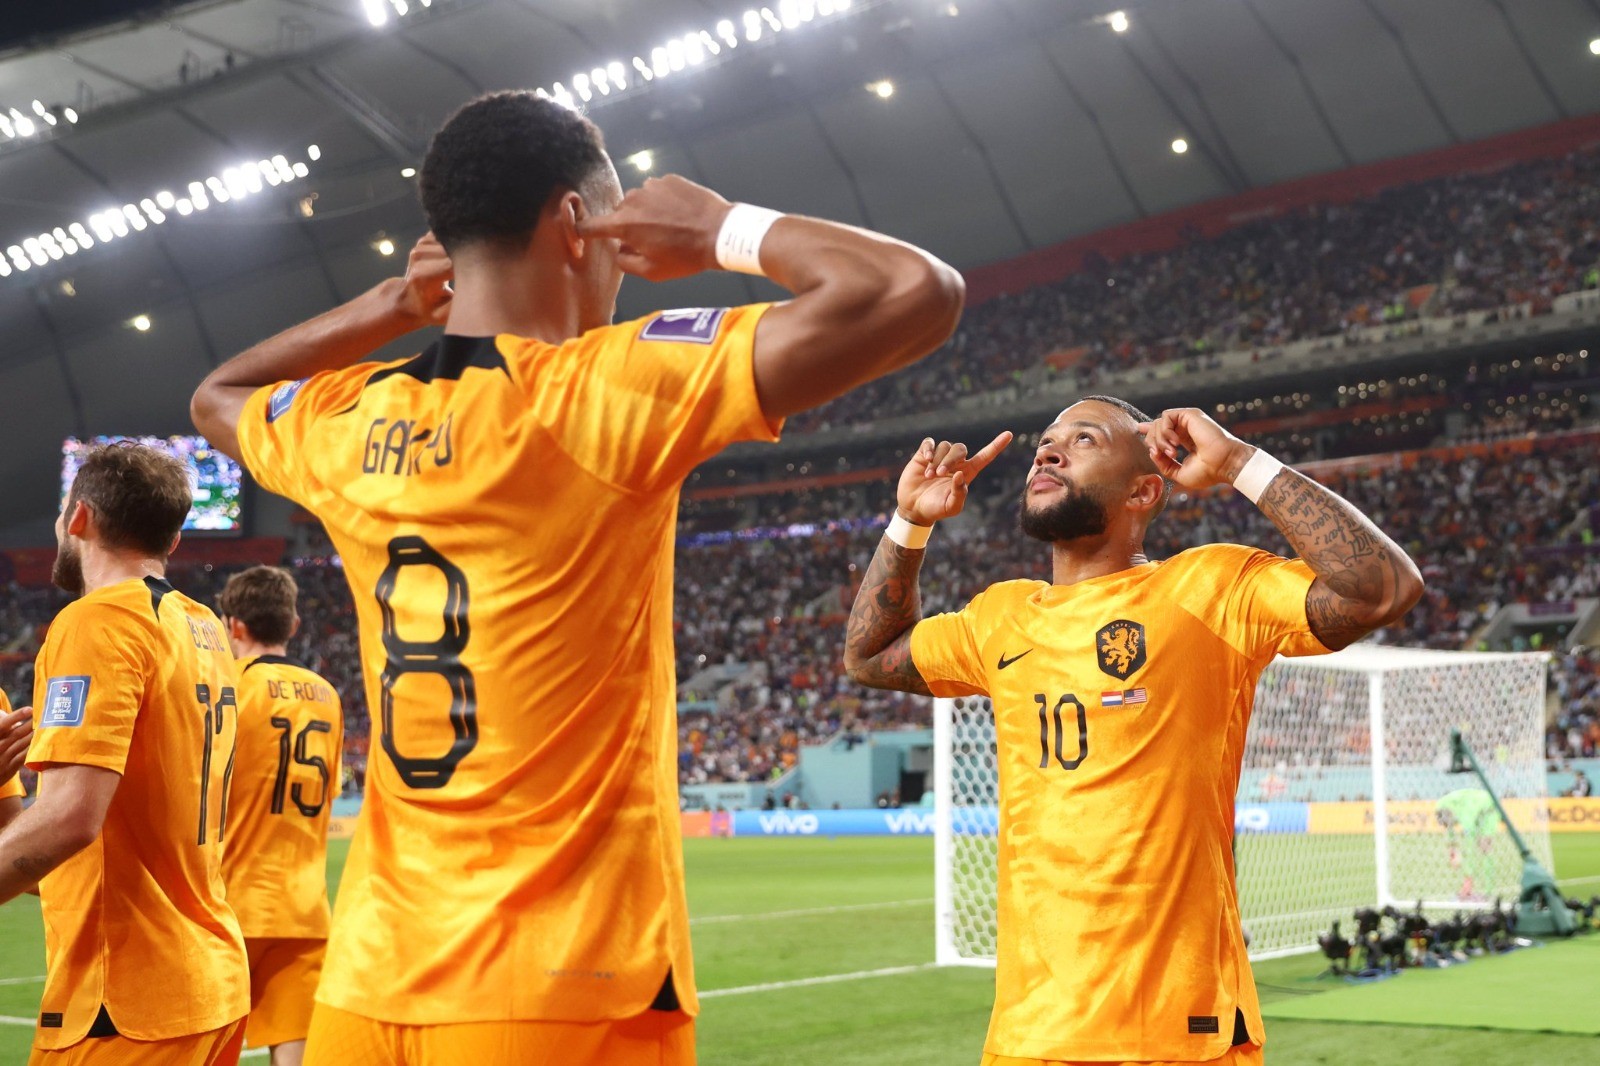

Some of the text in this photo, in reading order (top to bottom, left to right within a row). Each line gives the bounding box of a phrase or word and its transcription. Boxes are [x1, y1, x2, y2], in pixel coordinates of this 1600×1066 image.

[267, 679, 290, 700] DE
[375, 535, 479, 789] 8
[195, 683, 238, 846] 17
[270, 717, 333, 818] 15
[1034, 693, 1089, 771] 10
[758, 808, 819, 834] vivo
[883, 808, 936, 833] viv
